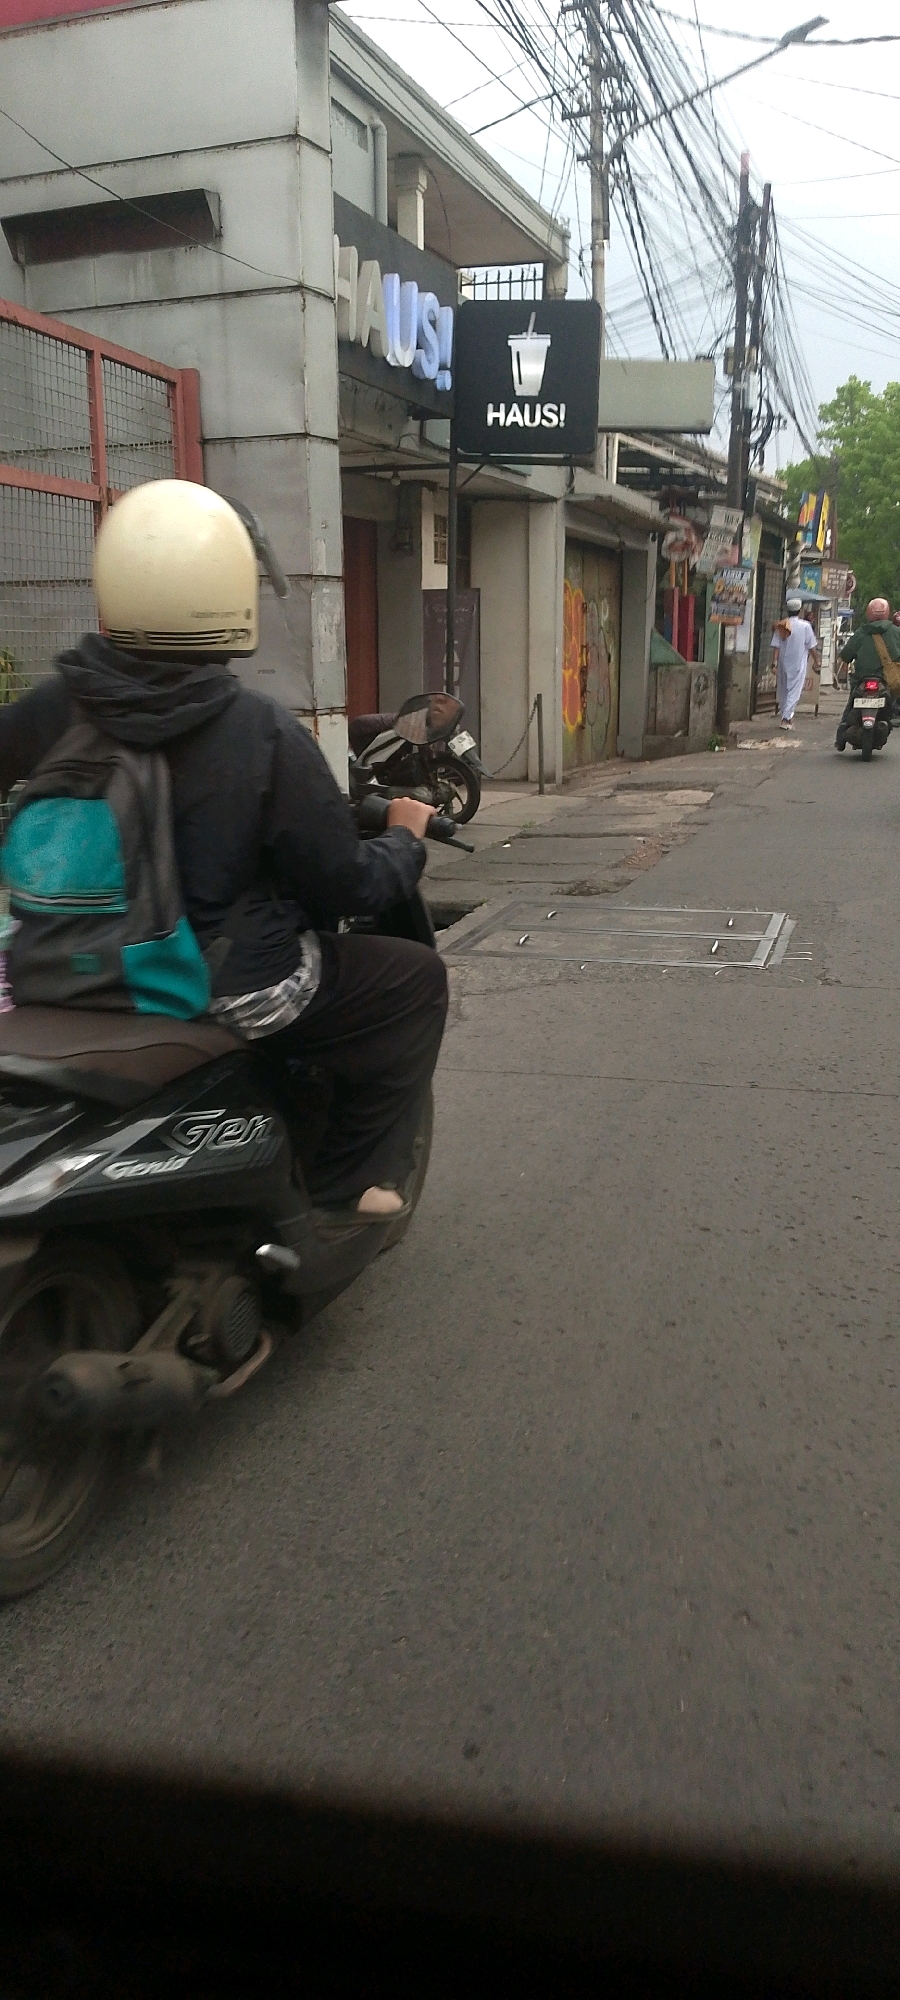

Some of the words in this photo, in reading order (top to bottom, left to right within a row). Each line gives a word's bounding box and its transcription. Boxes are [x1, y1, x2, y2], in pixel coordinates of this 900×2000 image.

[334, 234, 453, 391] HAUS!
[487, 403, 567, 428] HAUS!
[102, 1157, 192, 1180] Genio
